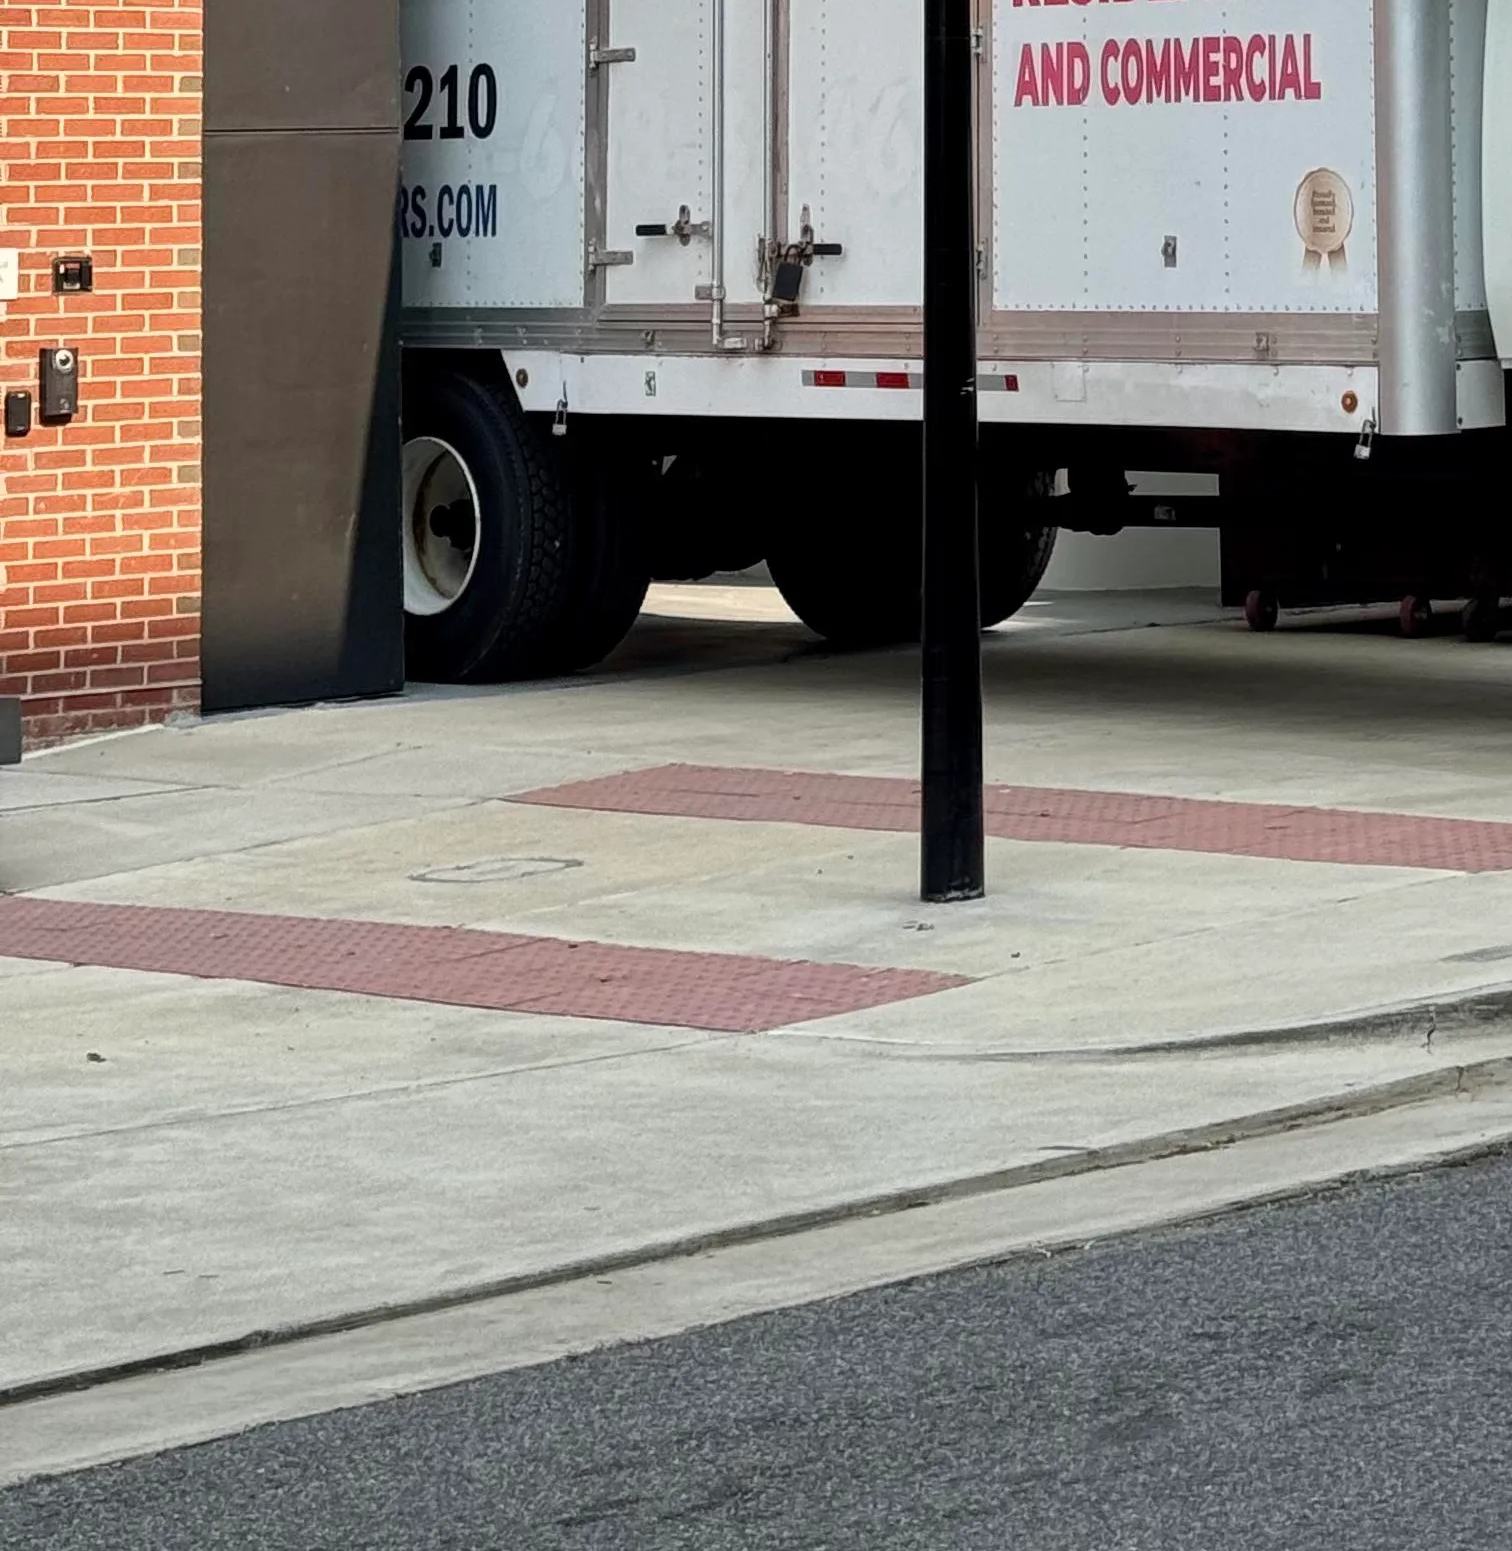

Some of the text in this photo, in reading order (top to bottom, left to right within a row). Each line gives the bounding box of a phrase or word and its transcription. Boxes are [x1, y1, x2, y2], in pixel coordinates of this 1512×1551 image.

[403, 63, 497, 140] 210
[1013, 33, 1321, 107] AND COMMERCIAL
